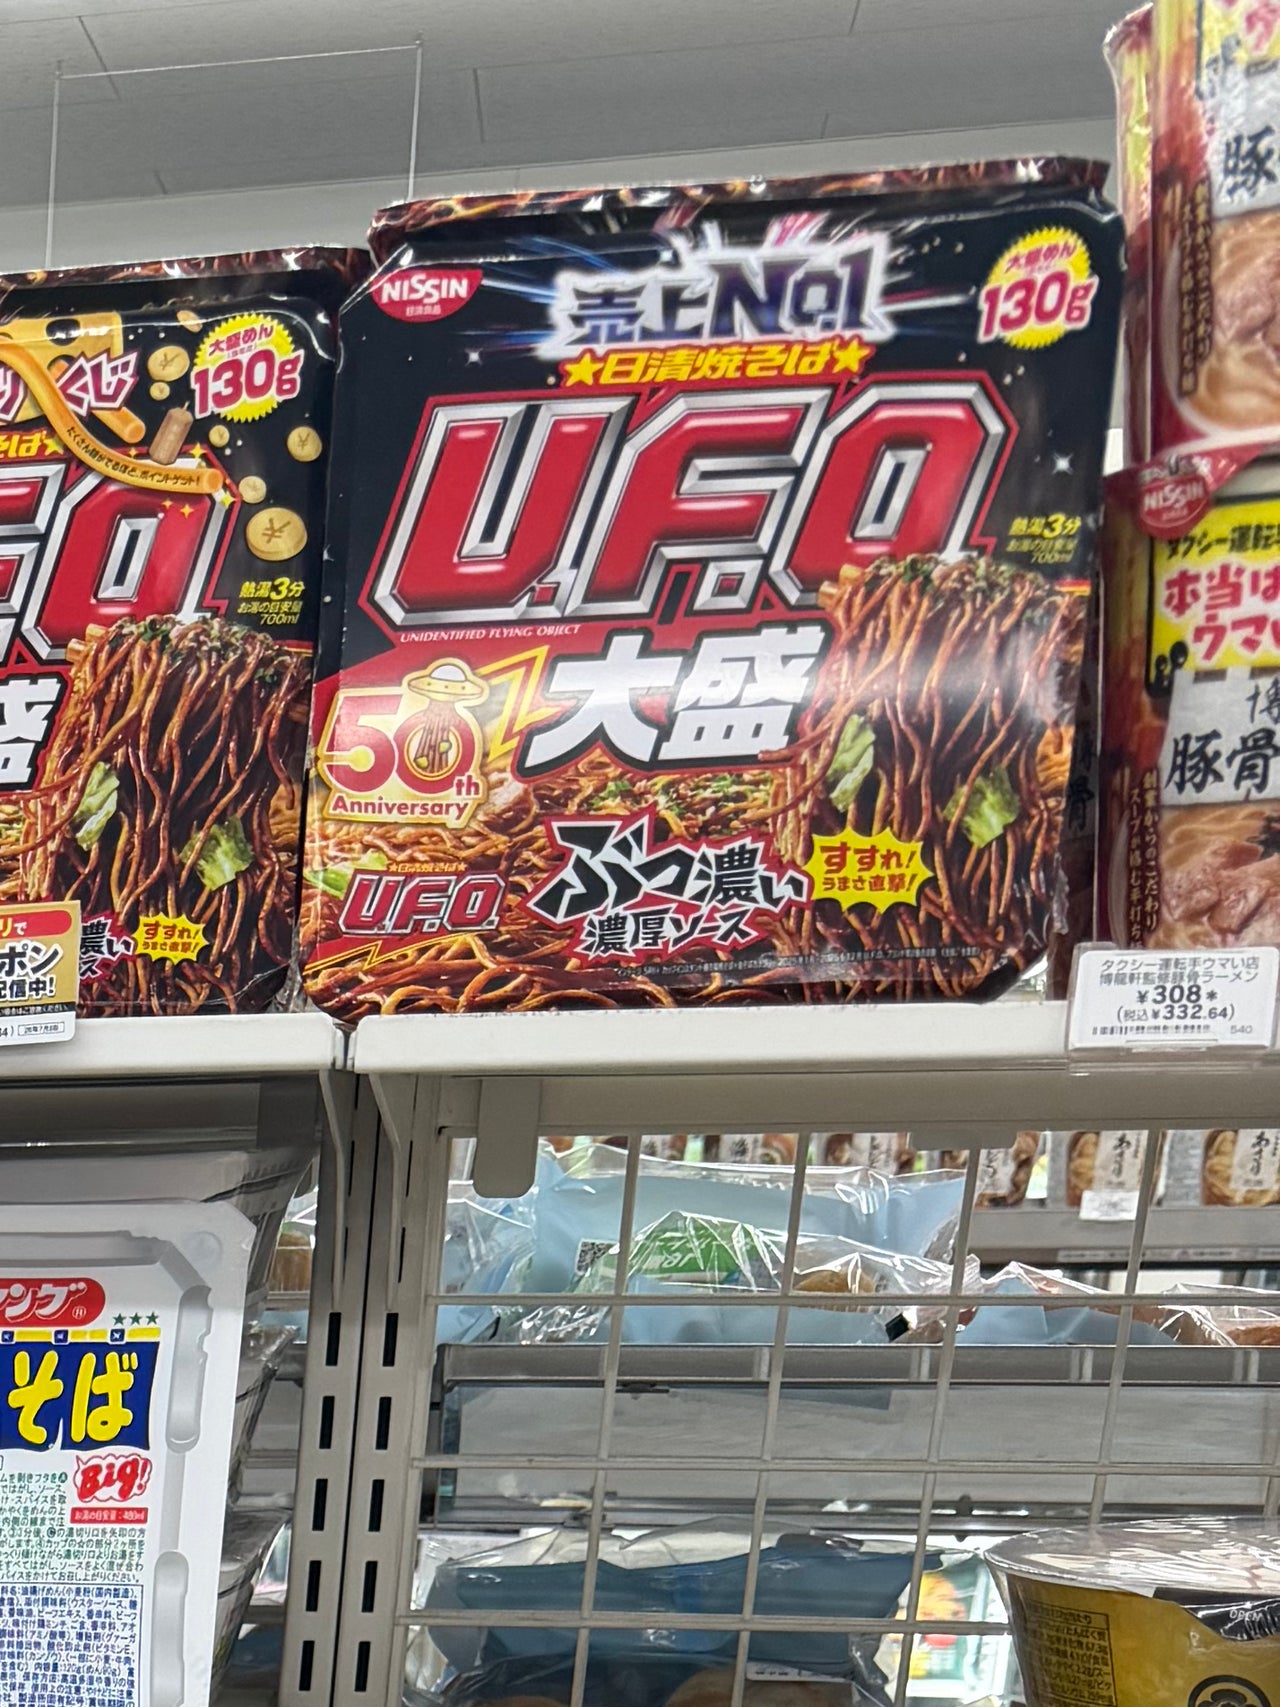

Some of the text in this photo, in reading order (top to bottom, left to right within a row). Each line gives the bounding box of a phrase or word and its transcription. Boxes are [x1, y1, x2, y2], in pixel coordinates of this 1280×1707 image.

[380, 275, 469, 303] NISSIN
[979, 274, 1099, 341] 130g
[208, 324, 273, 358] 大盛めん
[599, 345, 838, 384] 日清焼そば
[192, 347, 305, 418] 130g
[1143, 482, 1205, 511] NISSIN
[238, 577, 305, 600] 熱湯3分
[400, 623, 581, 645] UNIDENTIFIED FLYING OBJECT
[526, 625, 824, 767] 大盛
[1164, 728, 1280, 795] 豚骨
[329, 794, 470, 821] Anniversary
[539, 819, 813, 908] ぶっ濃い
[821, 839, 918, 875] すすれ!
[821, 870, 920, 895] うまさ直撃!
[141, 916, 201, 941] すすれ!
[584, 903, 756, 955] 濃厚ソース
[1102, 957, 1260, 972] タクシー運転手ウマい店
[79, 1456, 148, 1500] Big!
